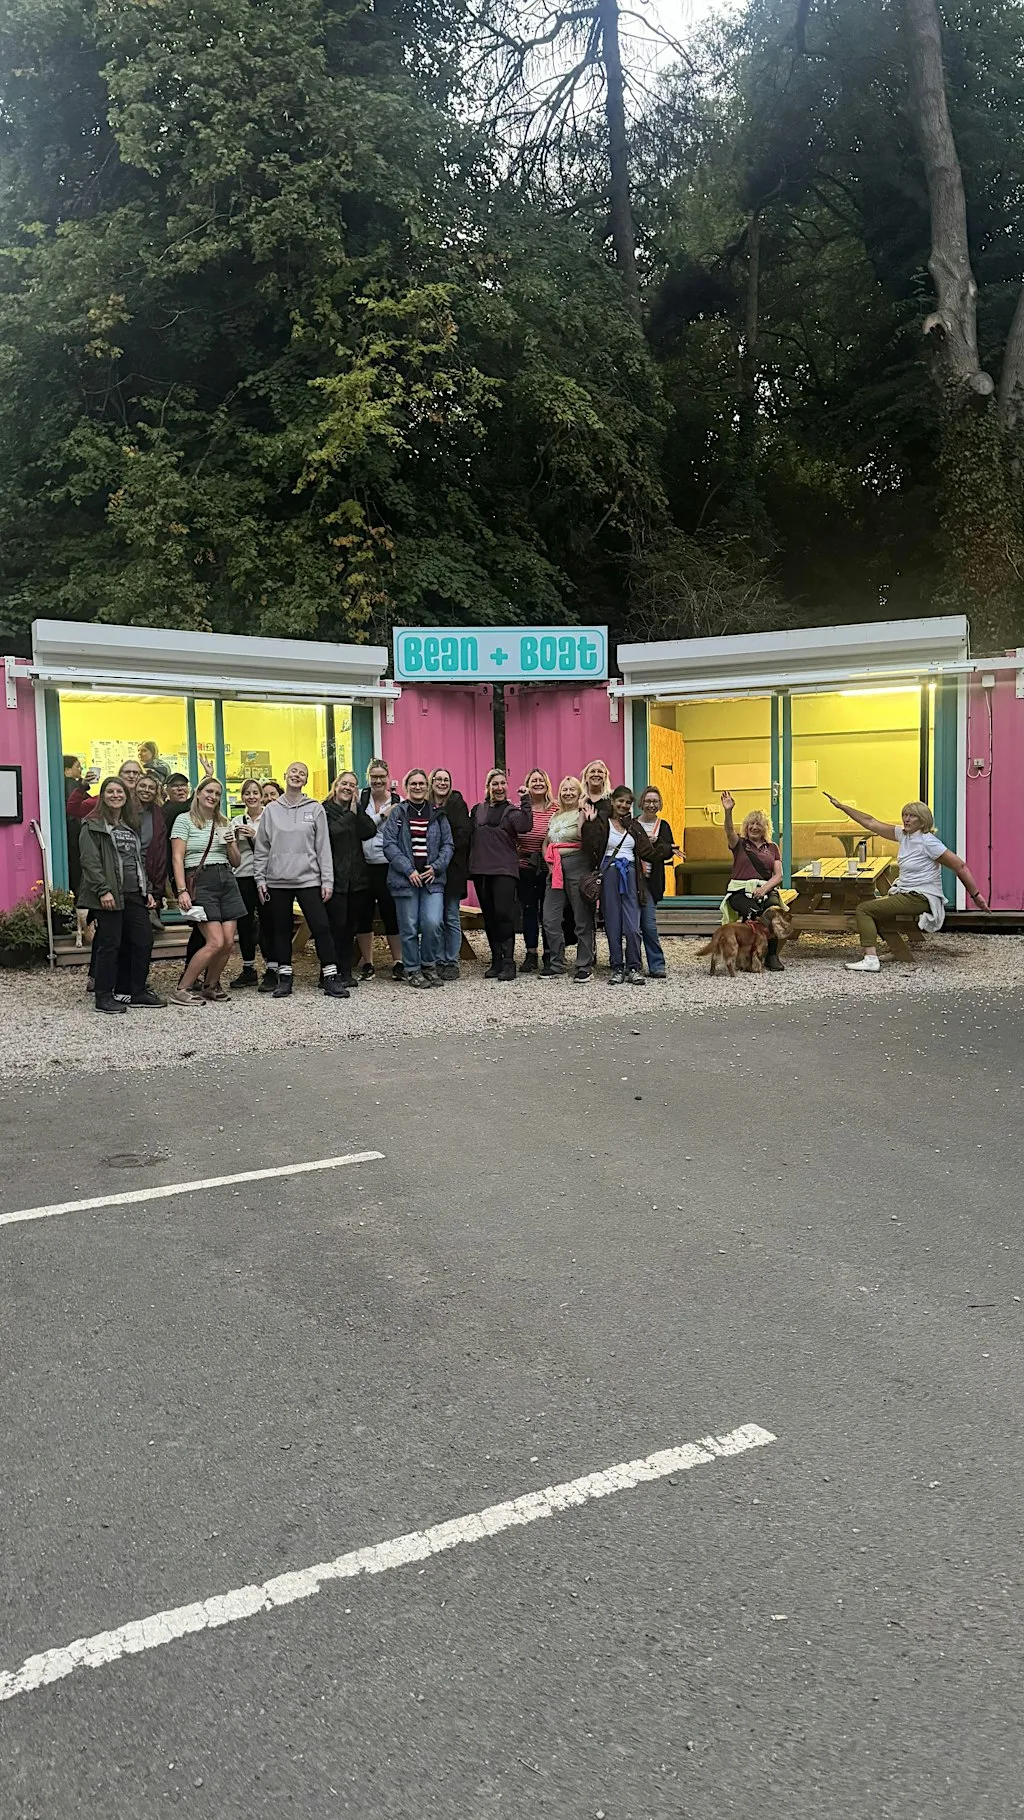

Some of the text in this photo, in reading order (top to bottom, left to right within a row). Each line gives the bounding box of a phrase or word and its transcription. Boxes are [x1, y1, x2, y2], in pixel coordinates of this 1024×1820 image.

[404, 636, 598, 672] Bean + Boat
